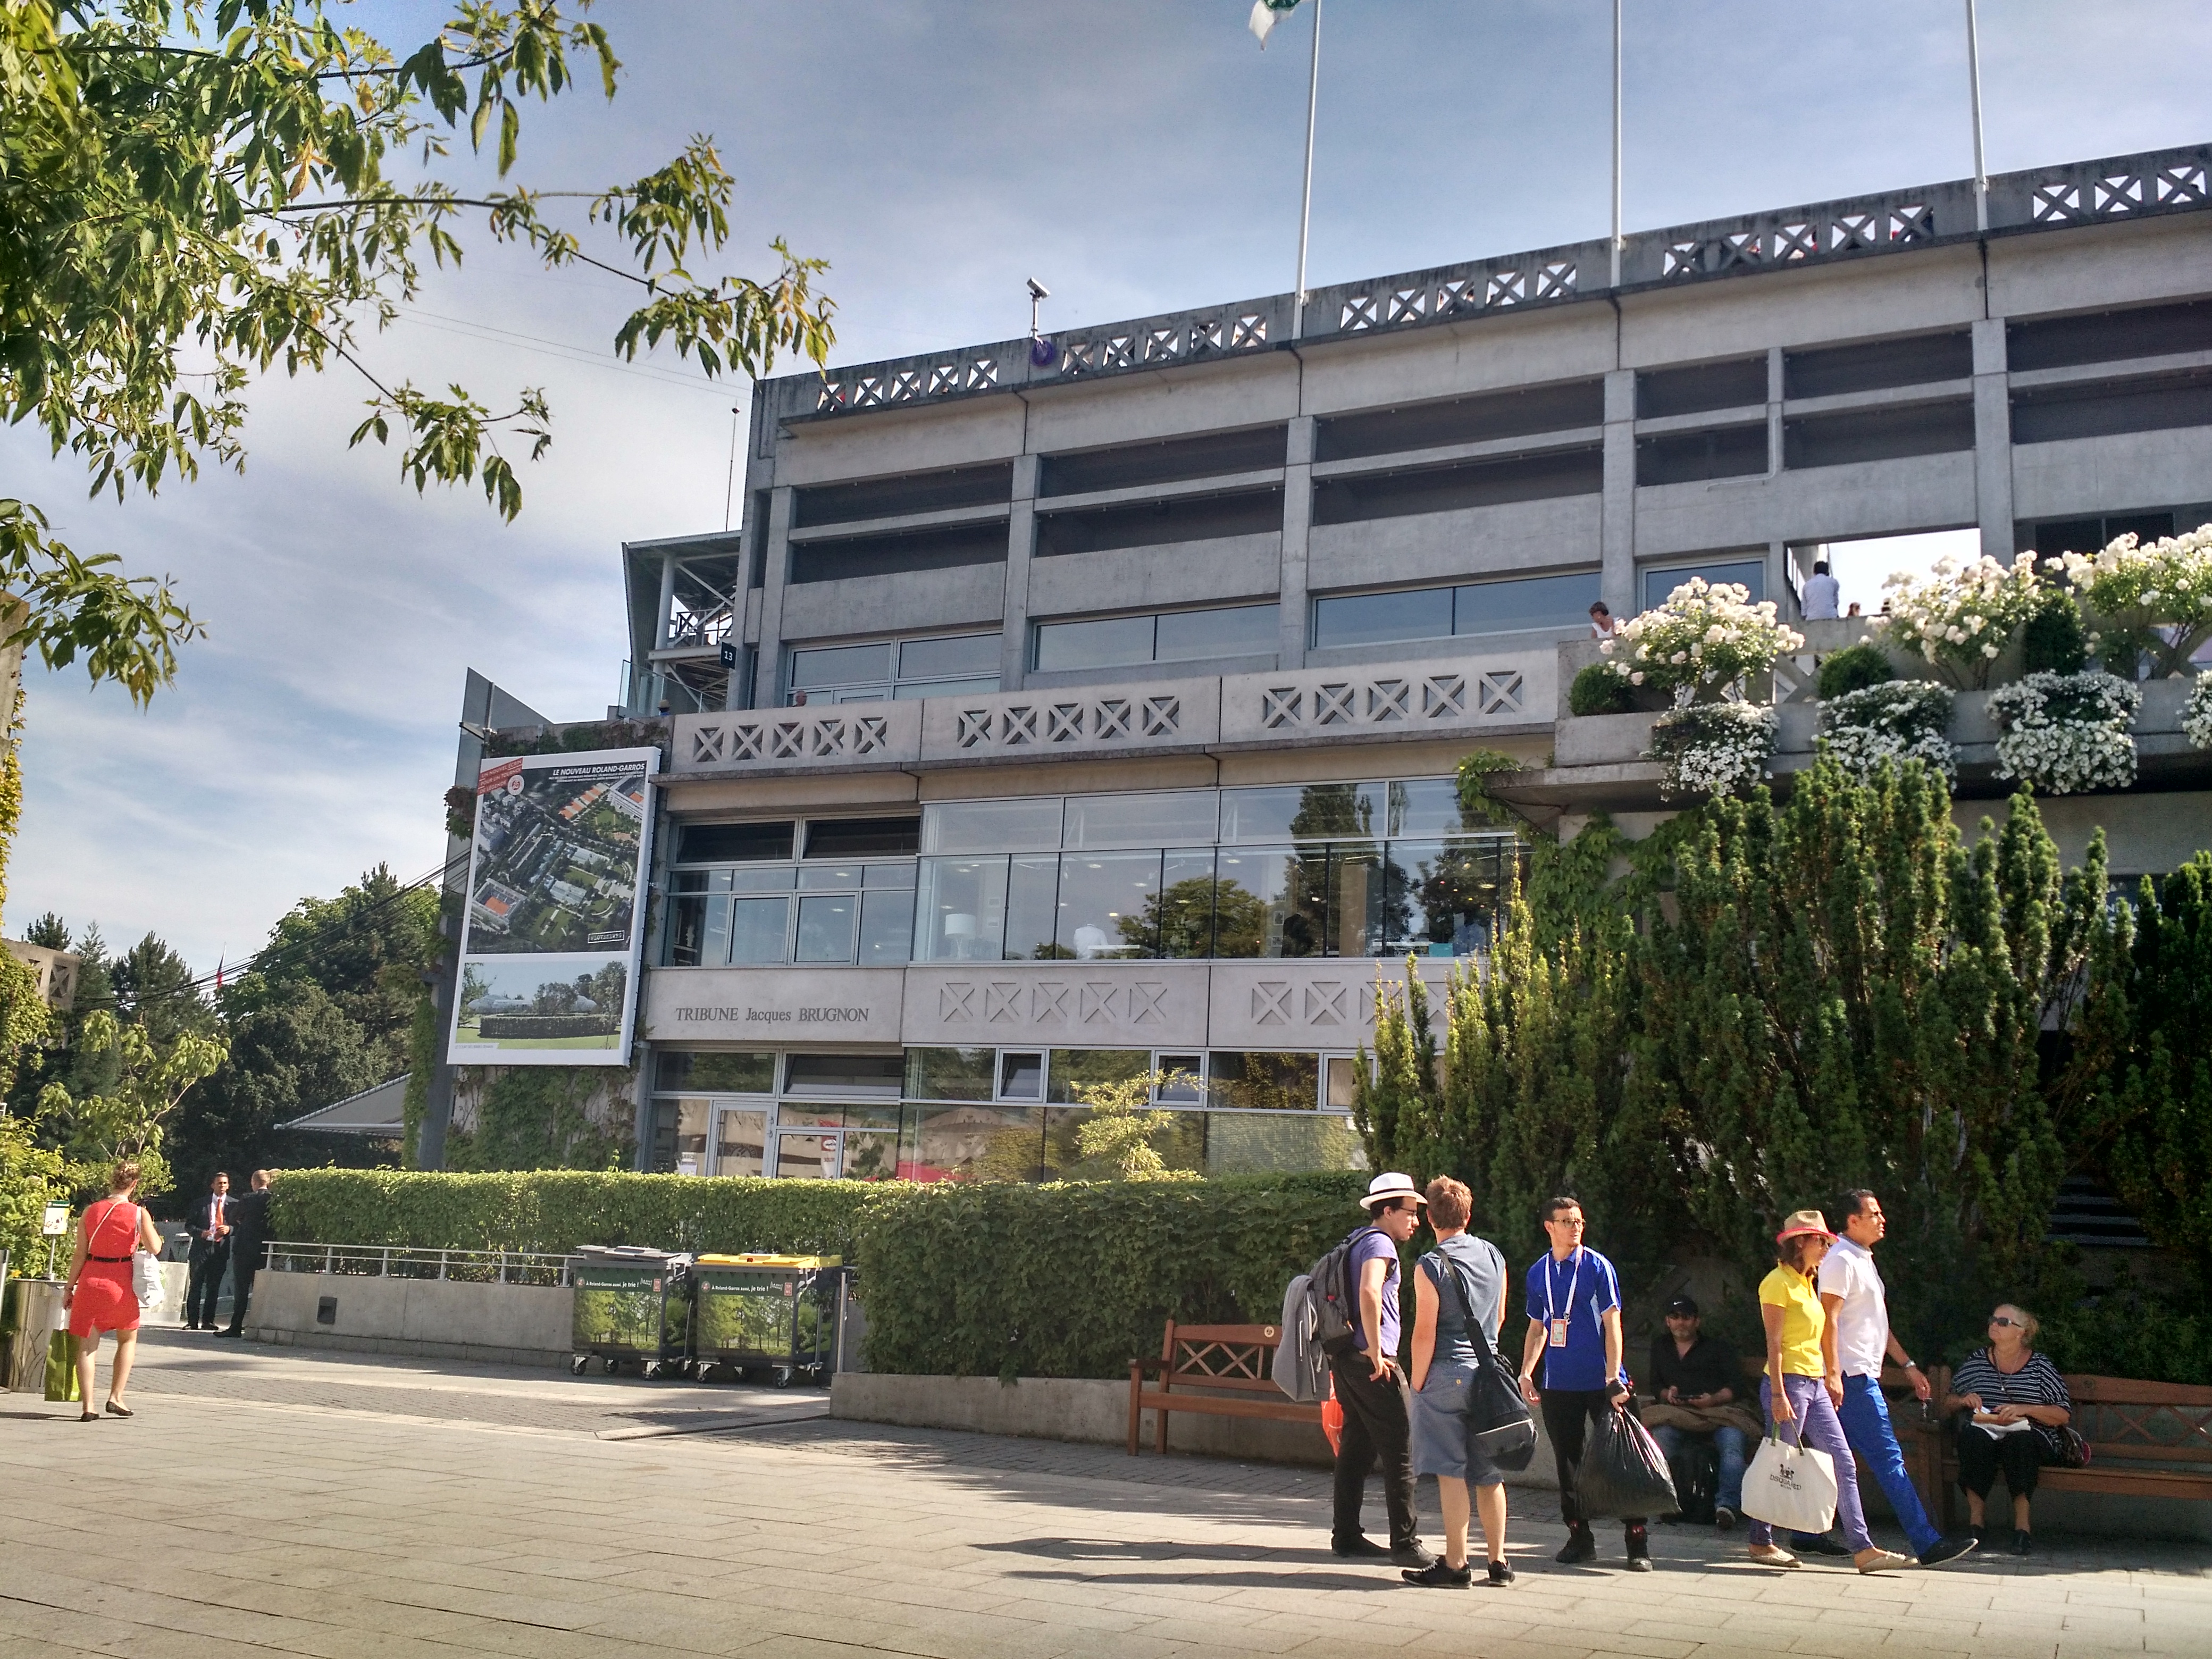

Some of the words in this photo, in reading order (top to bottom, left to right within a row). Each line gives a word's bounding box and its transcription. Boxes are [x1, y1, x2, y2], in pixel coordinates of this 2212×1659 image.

[724, 651, 733, 661] 13
[560, 767, 591, 776] NOUVEAU
[592, 764, 645, 774] ROLAND-GARROS
[676, 1008, 739, 1021] TRIBUNE
[745, 1008, 791, 1024] Jacques
[798, 1008, 869, 1021] BRUGNON
[1770, 1474, 1802, 1490] DSQUAED
